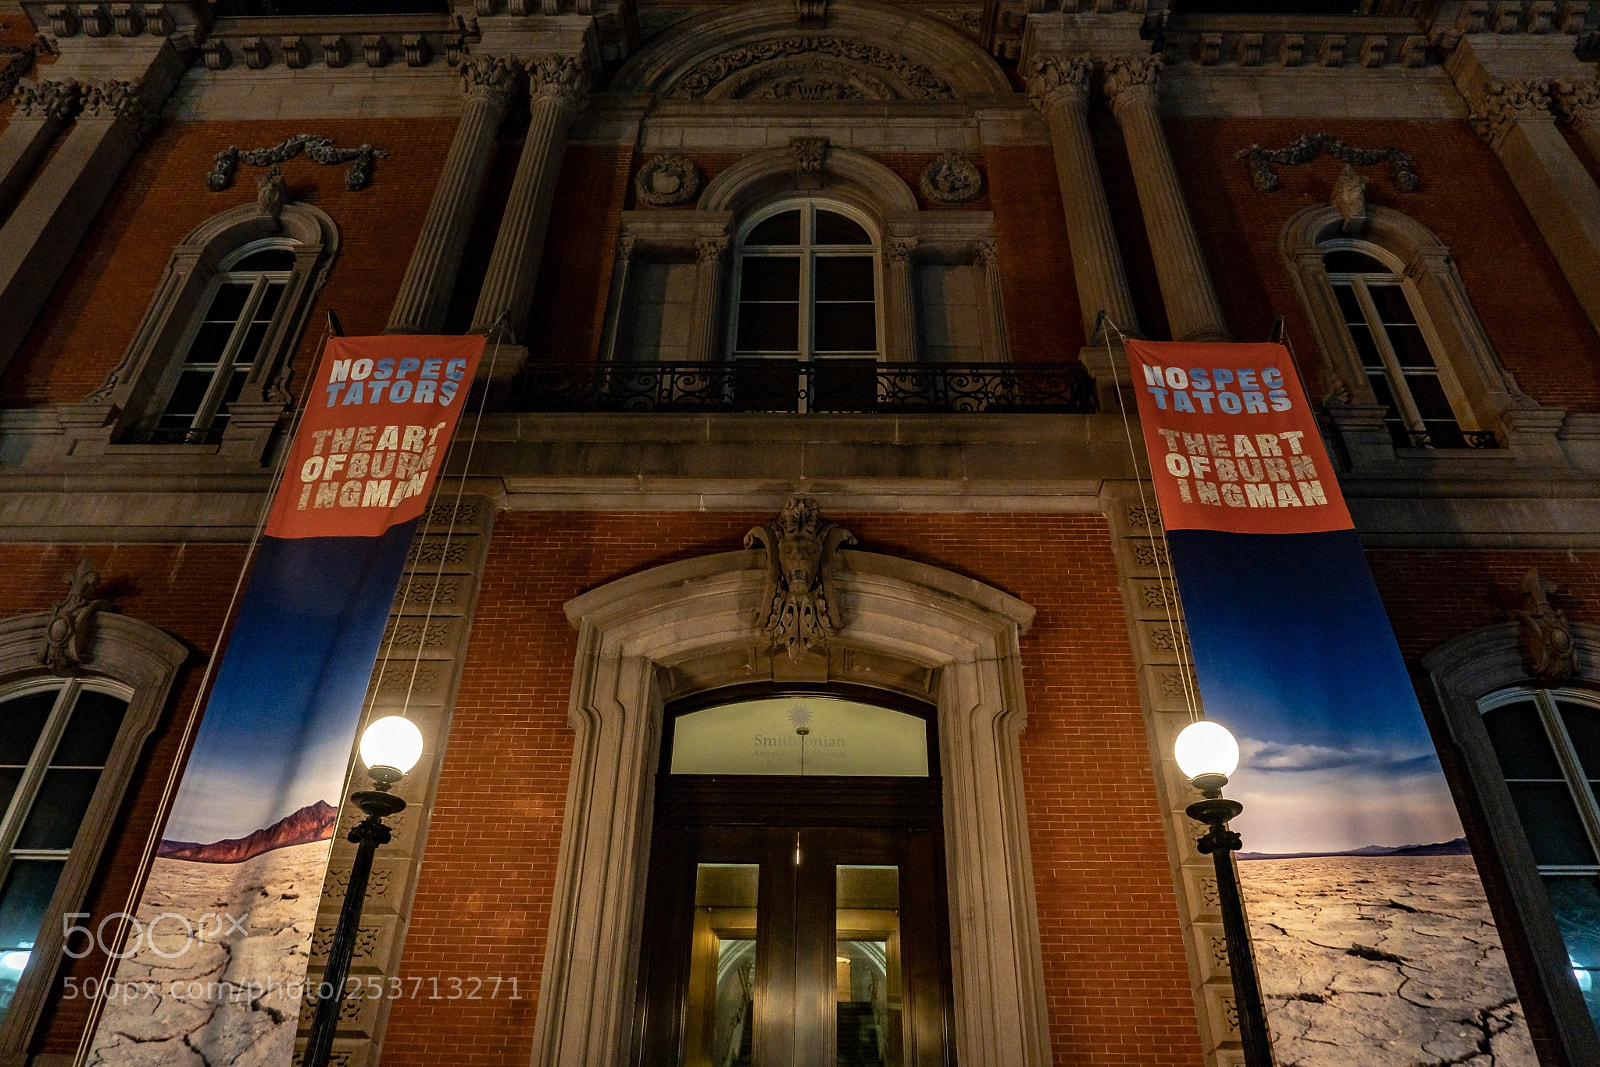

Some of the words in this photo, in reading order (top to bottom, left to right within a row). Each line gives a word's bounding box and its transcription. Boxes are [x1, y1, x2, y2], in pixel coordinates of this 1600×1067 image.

[326, 380, 459, 407] TATORS
[1148, 387, 1292, 414] TATORS
[754, 733, 845, 748] Smithsonian
